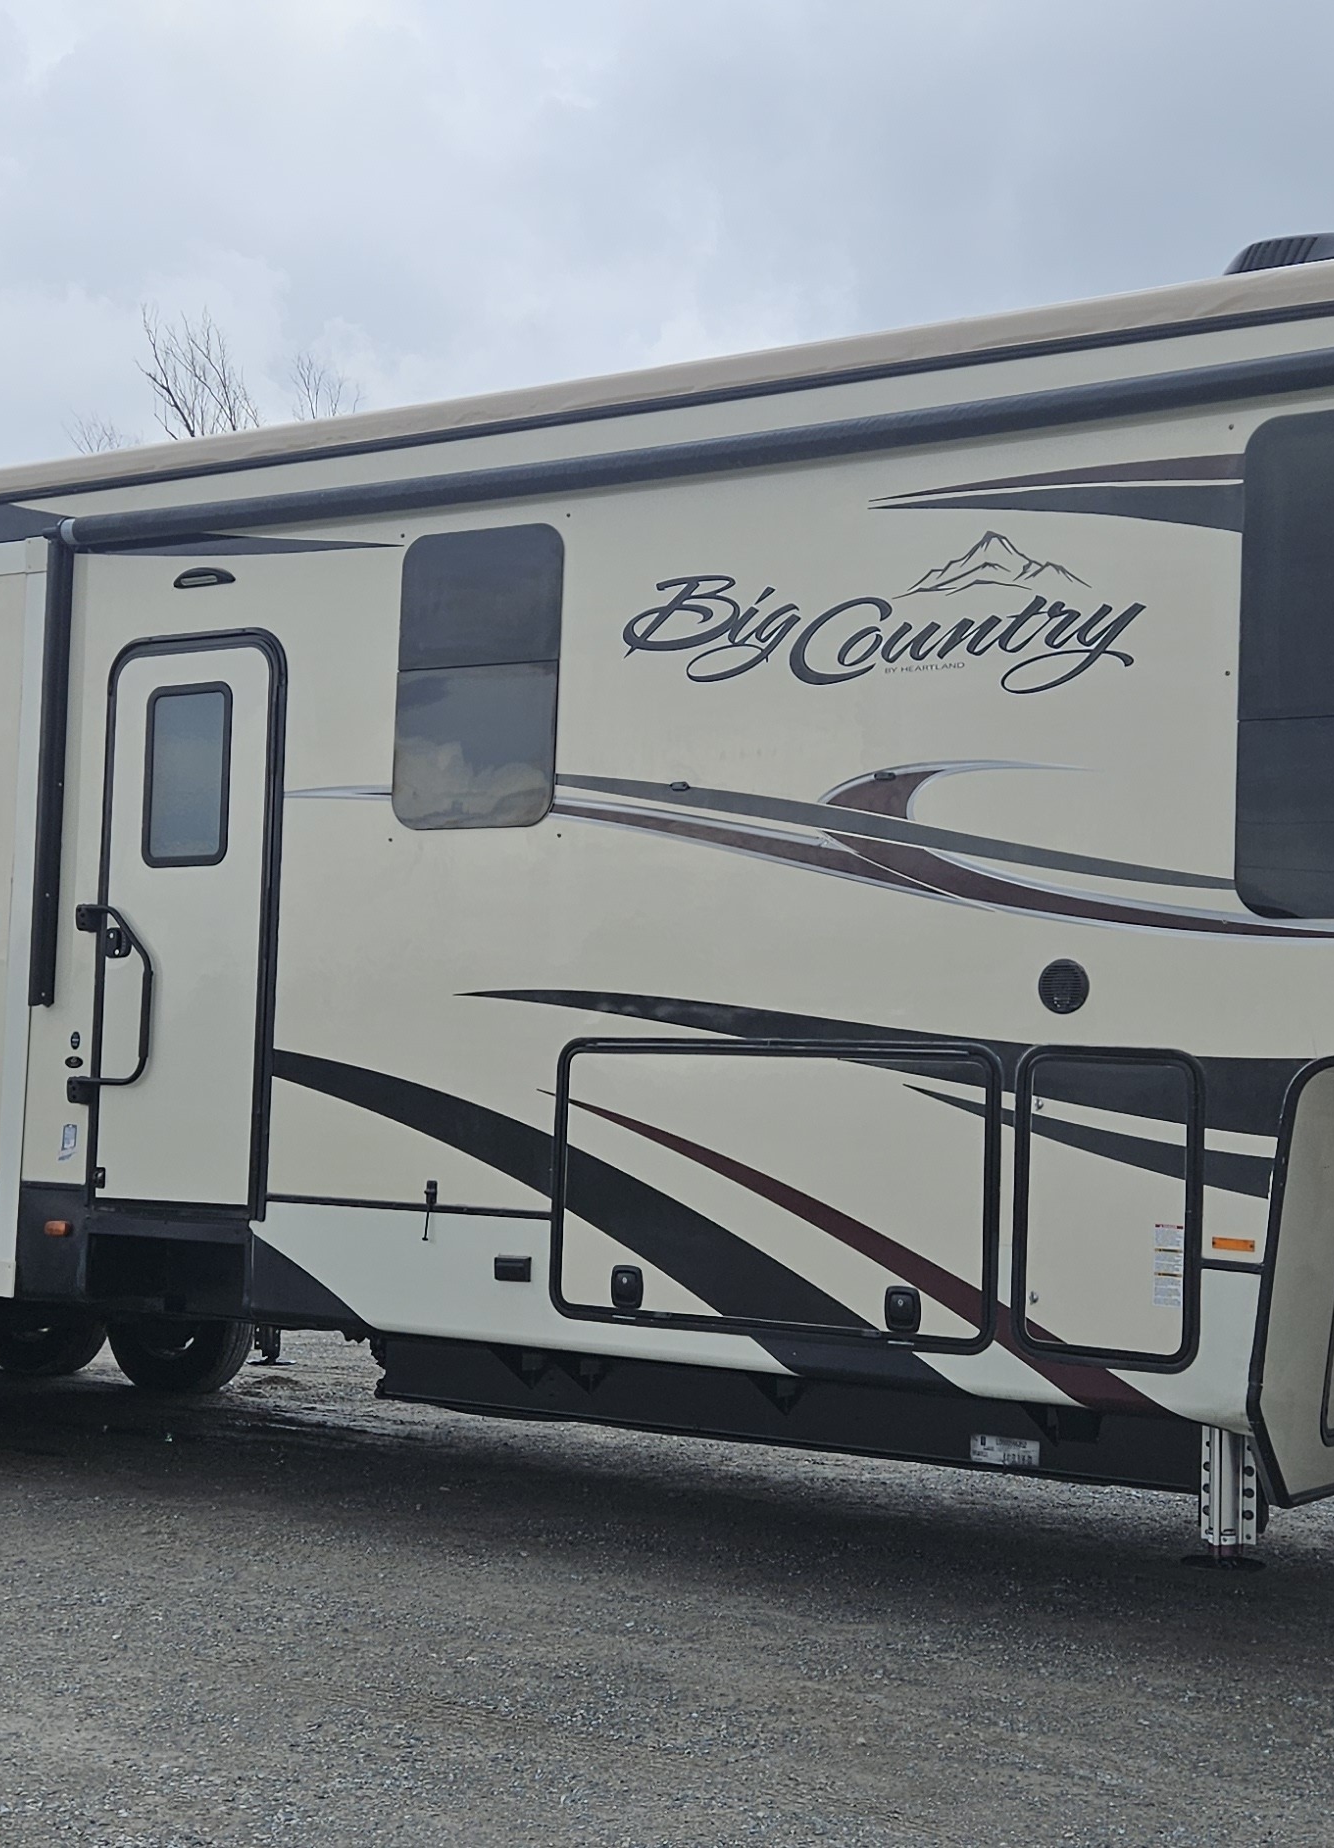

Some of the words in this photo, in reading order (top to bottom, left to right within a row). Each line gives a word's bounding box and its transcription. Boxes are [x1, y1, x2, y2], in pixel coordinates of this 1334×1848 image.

[622, 575, 801, 683] Big
[788, 595, 1146, 694] Country
[885, 666, 897, 674] BY
[901, 662, 965, 673] HEARTLAND
